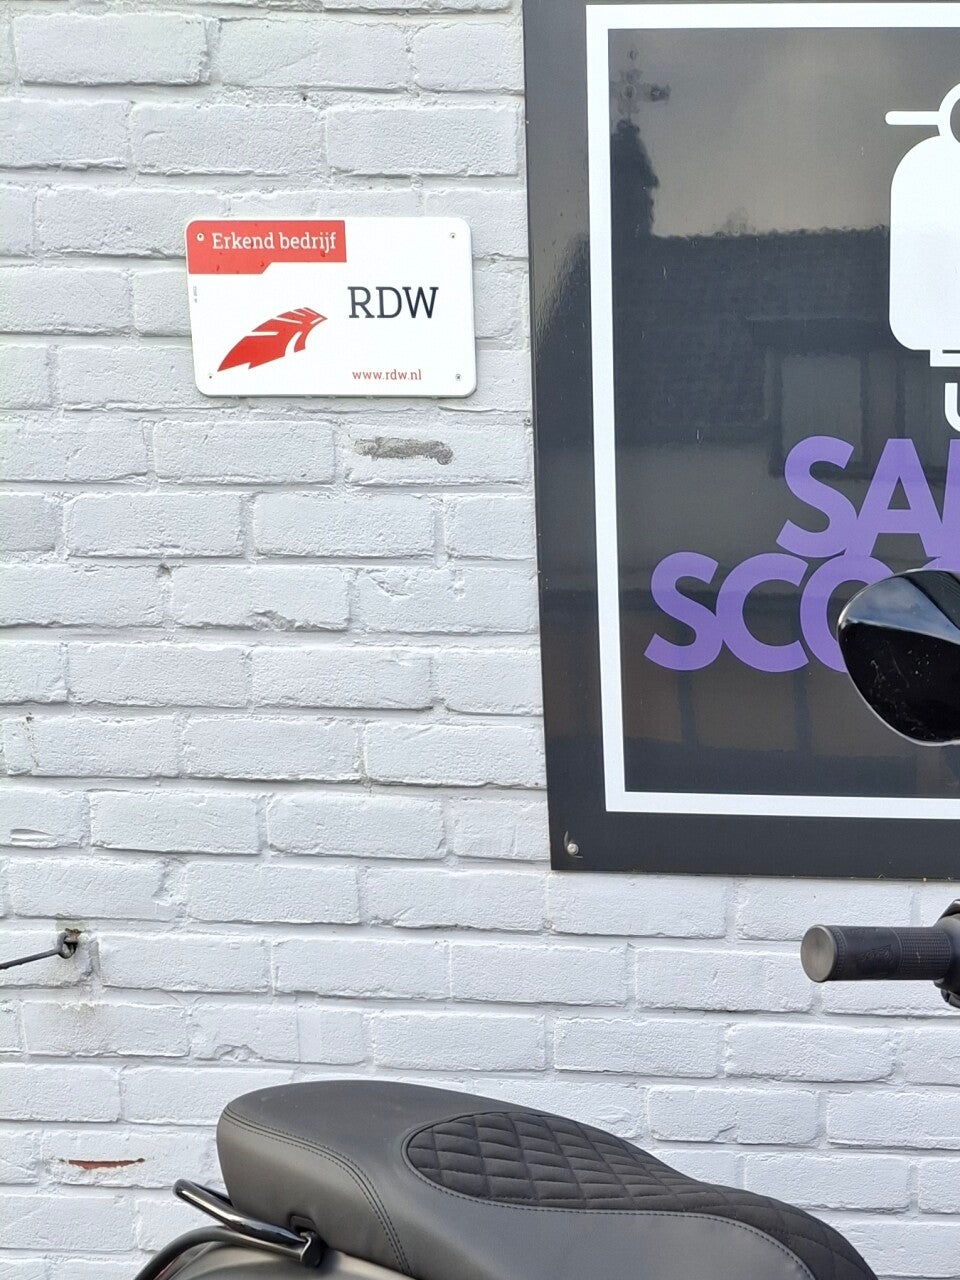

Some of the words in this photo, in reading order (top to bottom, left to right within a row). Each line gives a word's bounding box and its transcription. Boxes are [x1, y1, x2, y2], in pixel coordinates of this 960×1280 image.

[212, 232, 275, 250] Erkend
[279, 231, 337, 253] bedrijf
[347, 286, 439, 319] RDW
[352, 369, 422, 381] www.rdw.nl
